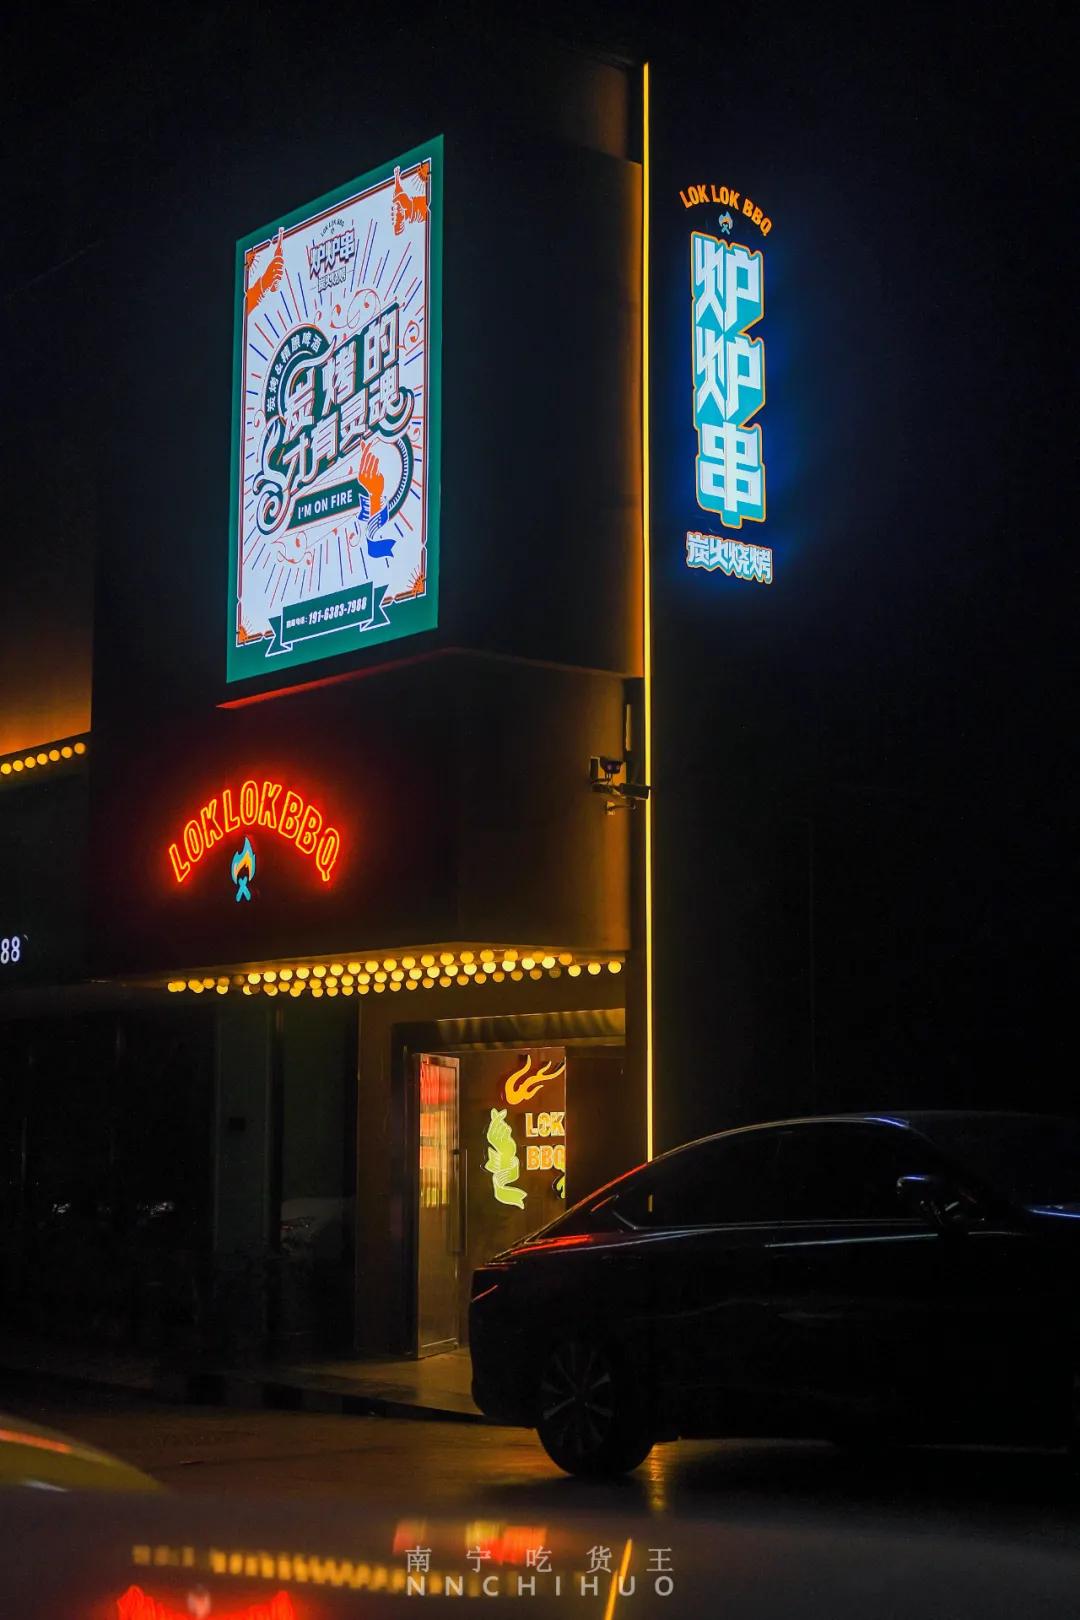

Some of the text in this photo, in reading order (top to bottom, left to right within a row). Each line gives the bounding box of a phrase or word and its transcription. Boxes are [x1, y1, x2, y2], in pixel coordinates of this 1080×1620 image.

[679, 184, 773, 236] LOK LOK BBQ
[310, 231, 355, 278] 炉炉串
[284, 307, 399, 444] 炭烤的
[693, 235, 764, 516] 炉炉串
[283, 365, 404, 488] 才有灵魂
[297, 489, 353, 519] I'M ON FIRE
[686, 532, 772, 582] 炭火烧烤
[0, 936, 21, 964] 88
